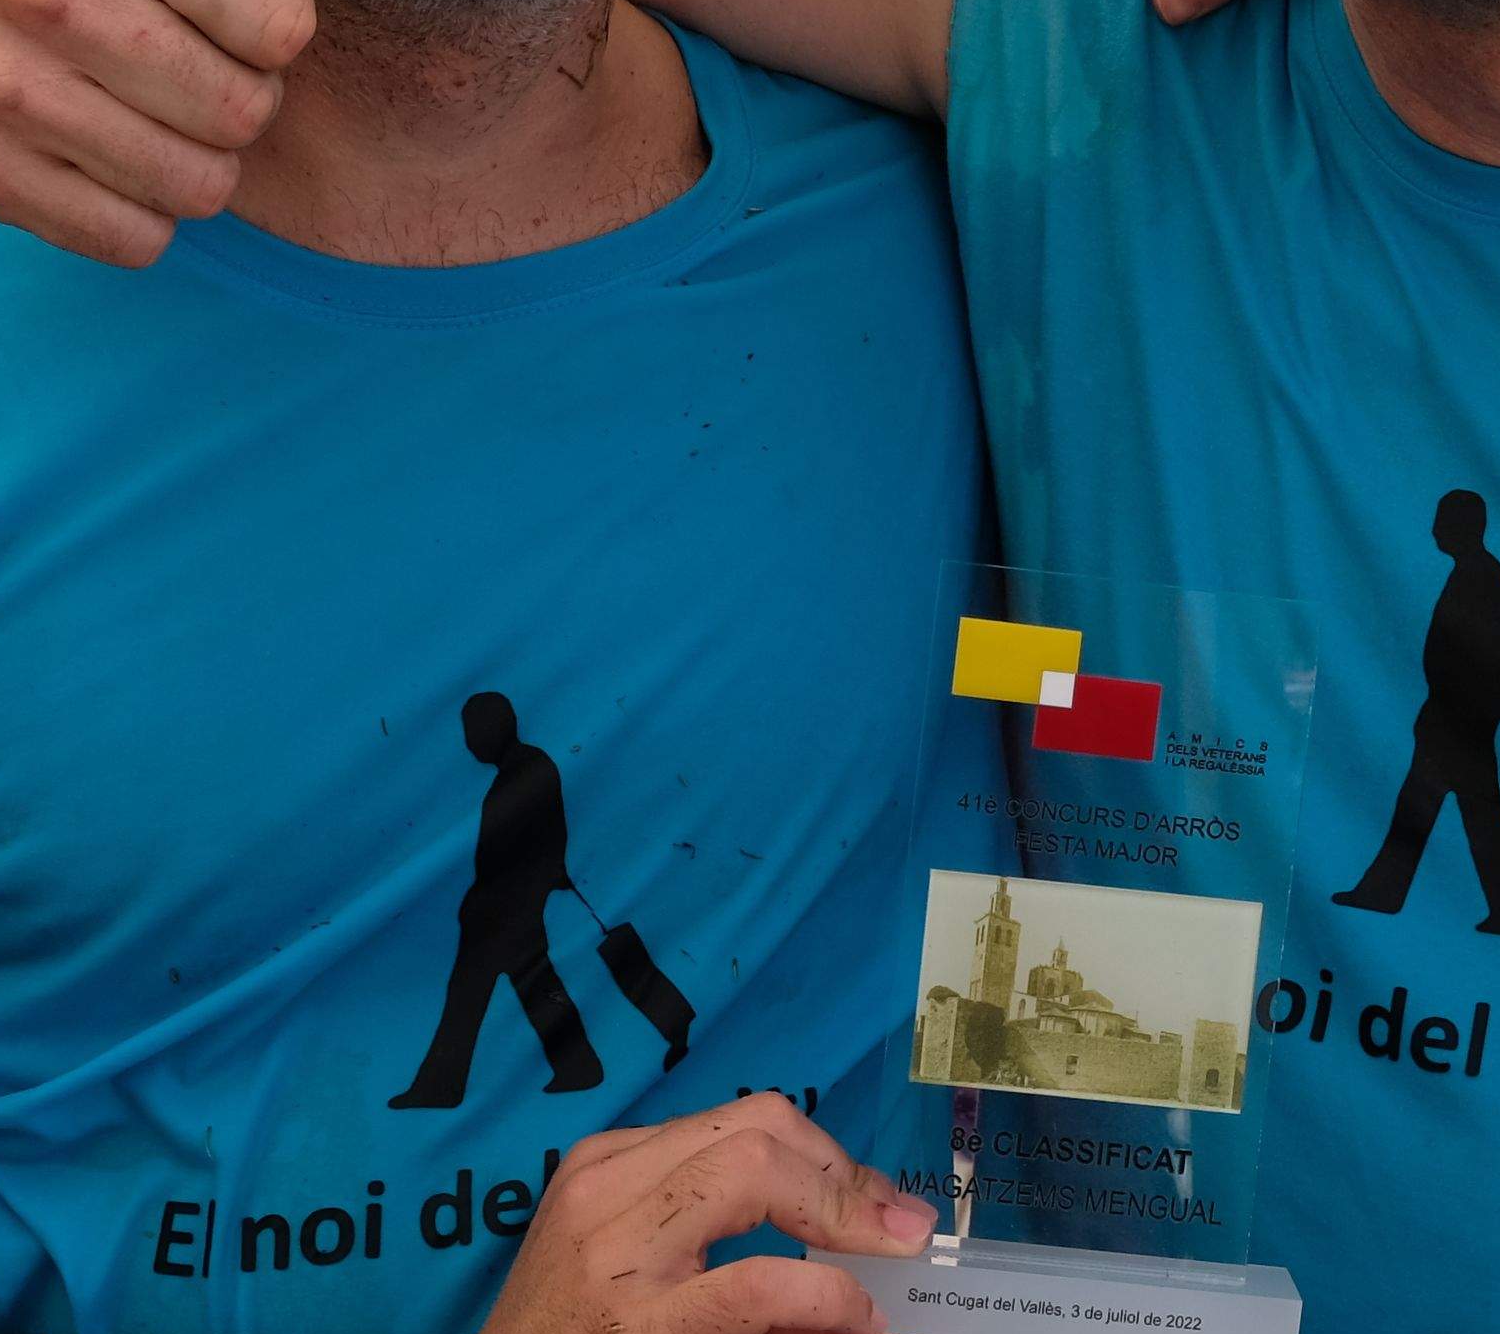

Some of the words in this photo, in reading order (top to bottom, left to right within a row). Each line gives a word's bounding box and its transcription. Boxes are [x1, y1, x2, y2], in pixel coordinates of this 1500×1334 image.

[1166, 744, 1198, 757] DELS
[1201, 747, 1267, 764] VETERANS
[1172, 757, 1186, 767] LA
[956, 793, 998, 814] 41è
[1005, 797, 1126, 829] CONCURS
[1133, 812, 1241, 842] D'ARRÒS
[1013, 829, 1088, 857] FESTA
[1095, 841, 1179, 868] MAJOR
[1256, 969, 1333, 1043] oi
[1357, 986, 1491, 1078] del
[950, 1127, 983, 1152] 8è
[993, 1131, 1193, 1176] CLASSIFICAT
[898, 1169, 1075, 1212] MAGATZEMS
[1085, 1188, 1222, 1225] MENGUAL
[153, 1198, 216, 1278] El
[240, 1179, 386, 1273] noi
[907, 1287, 941, 1304] Sant
[945, 1291, 990, 1311] Cugat
[992, 1297, 1016, 1312] del
[1020, 1298, 1067, 1319] Vallès,
[1070, 1304, 1081, 1318] 3
[1084, 1305, 1104, 1320] de
[1104, 1307, 1141, 1326] juliol
[1143, 1311, 1162, 1327] de
[1165, 1314, 1203, 1332] 2022
